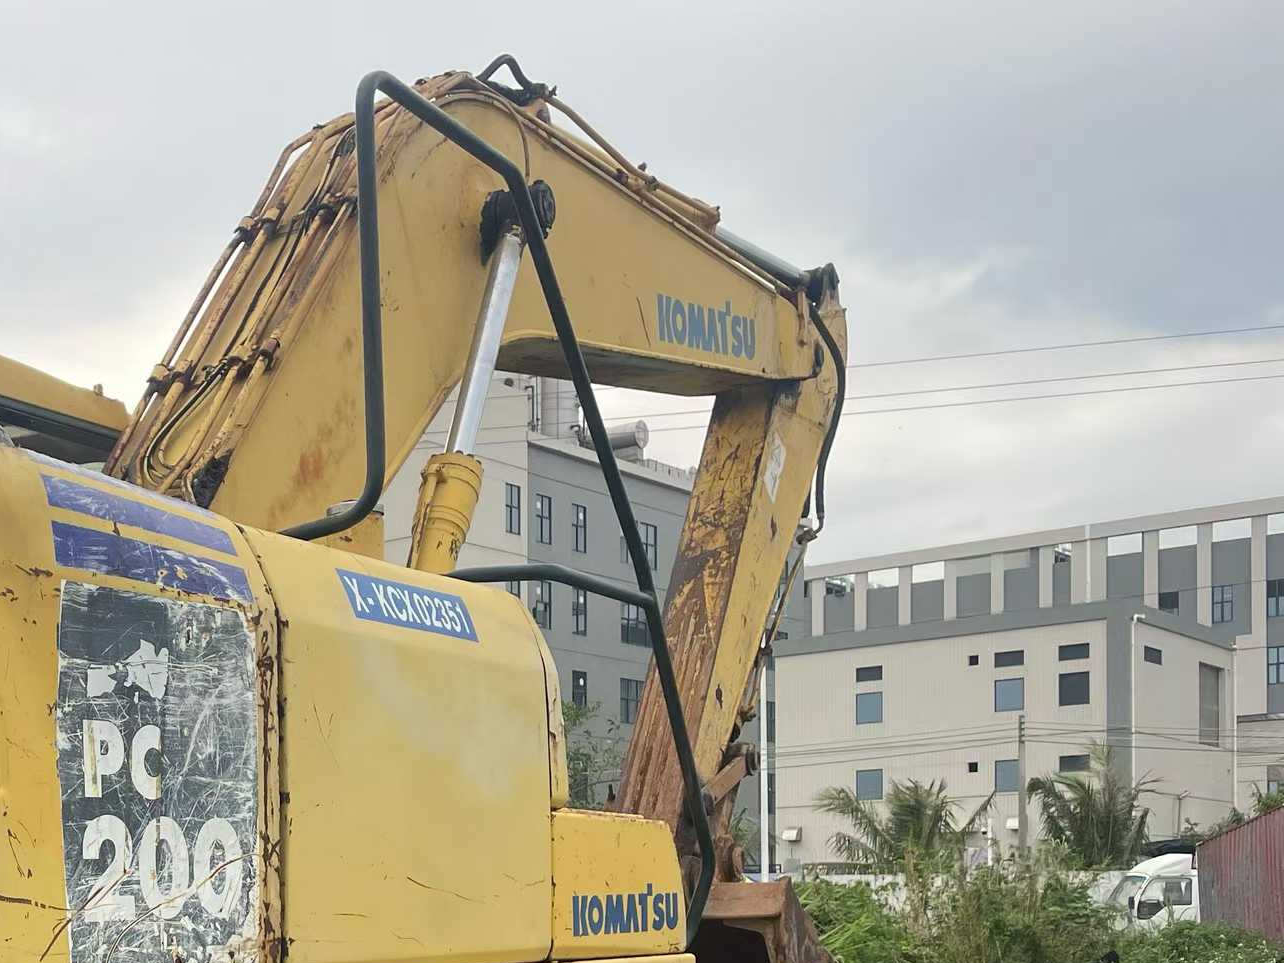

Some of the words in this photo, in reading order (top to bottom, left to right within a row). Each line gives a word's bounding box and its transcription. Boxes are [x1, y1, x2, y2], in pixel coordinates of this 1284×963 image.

[657, 293, 756, 361] KOMATSU
[82, 719, 163, 801] PC
[82, 814, 244, 922] 200
[572, 882, 679, 937] KOMATSU
